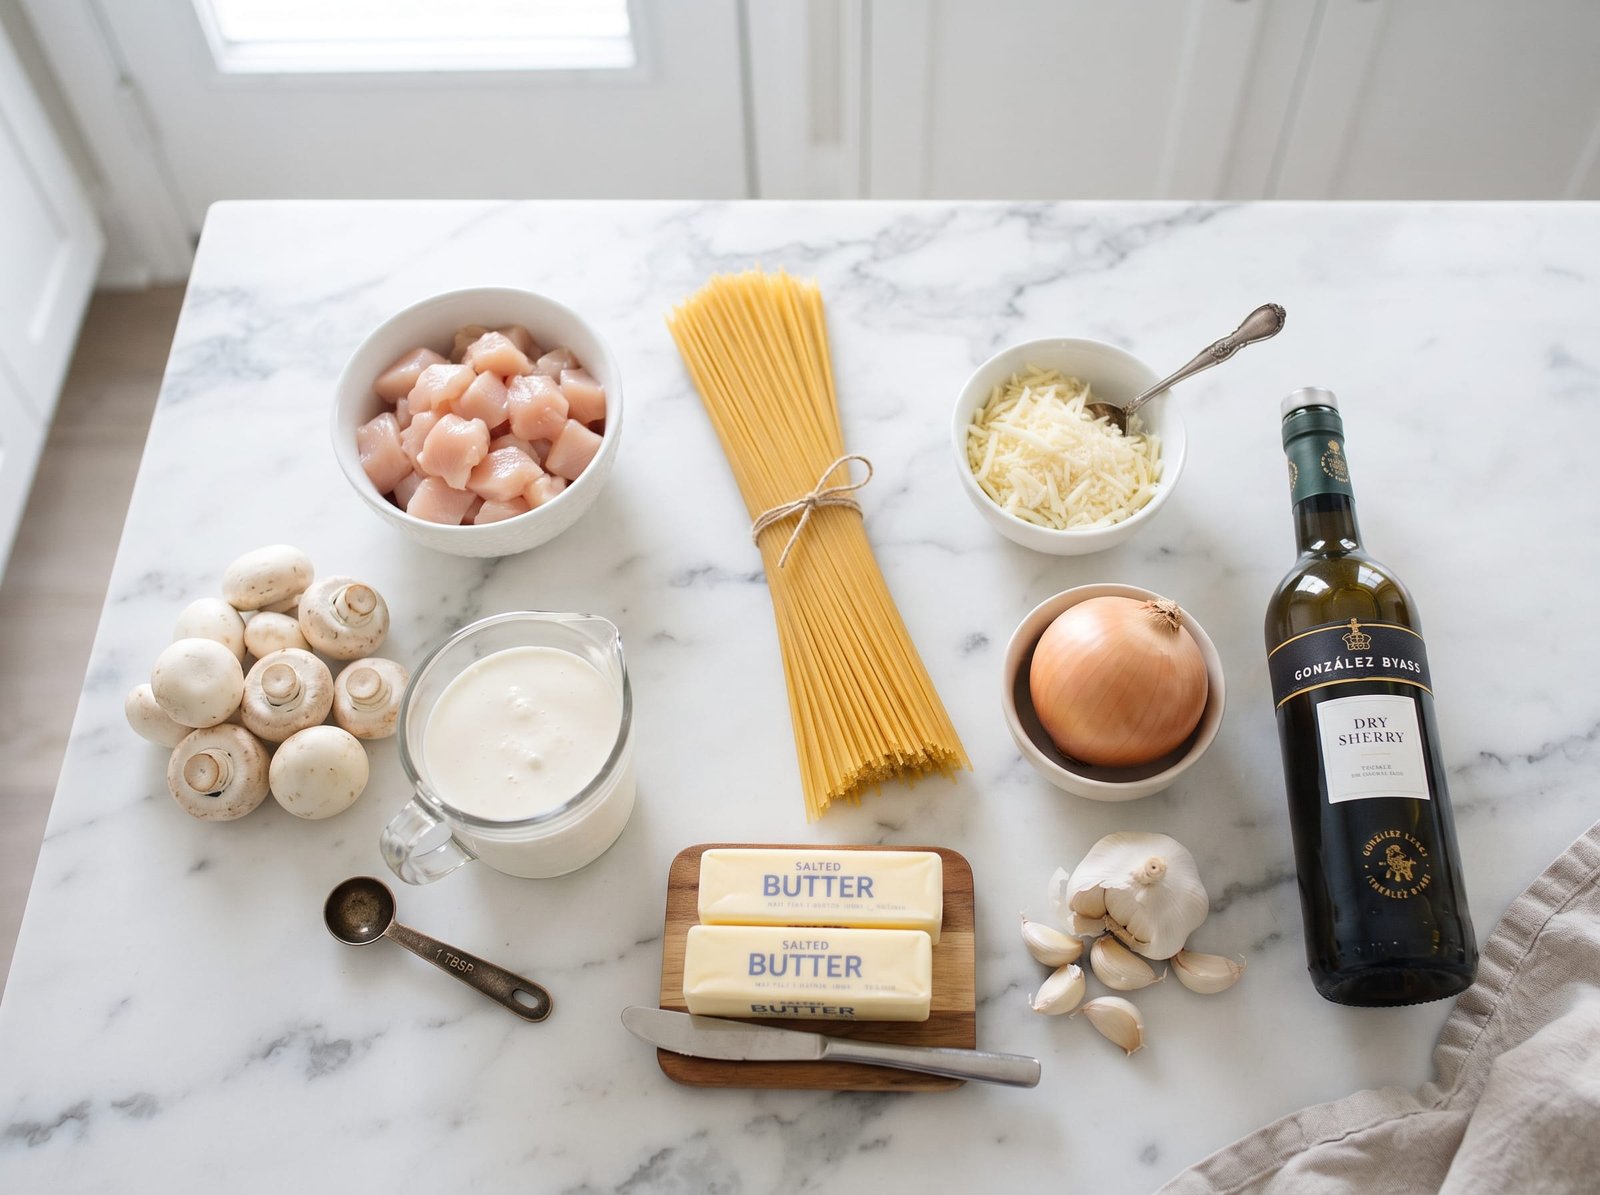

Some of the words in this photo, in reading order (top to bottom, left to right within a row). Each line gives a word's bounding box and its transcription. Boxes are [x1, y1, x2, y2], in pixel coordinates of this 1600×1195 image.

[1294, 656, 1375, 681] GONZÁLEZ
[1382, 657, 1421, 674] BYASS
[1354, 717, 1388, 730] DRY
[1338, 732, 1405, 746] SHERRY
[795, 861, 841, 871] SALTED
[763, 874, 874, 898] BUTTER
[782, 940, 829, 950] SALTED
[435, 949, 443, 960] 1
[444, 952, 474, 973] TBSP
[748, 953, 862, 978] BUTTER
[751, 1004, 856, 1015] BUTTER
